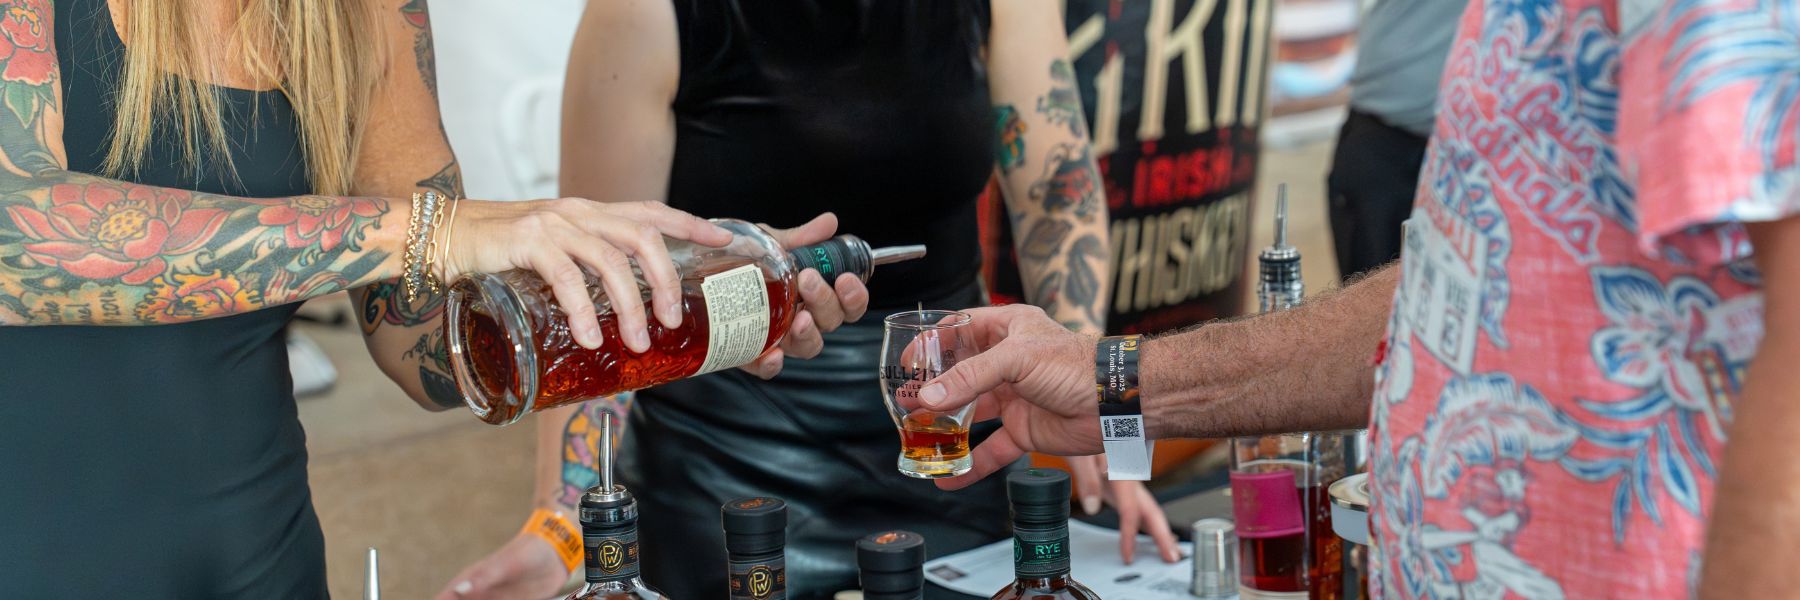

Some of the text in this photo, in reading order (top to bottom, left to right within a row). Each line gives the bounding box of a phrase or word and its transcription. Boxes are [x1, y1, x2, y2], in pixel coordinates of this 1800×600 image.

[1132, 148, 1234, 206] IRISH
[814, 247, 832, 274] RYE
[1108, 353, 1117, 374] Louis,
[1110, 375, 1117, 388] MO
[1118, 374, 1126, 392] 2025
[1035, 543, 1061, 555] RYE
